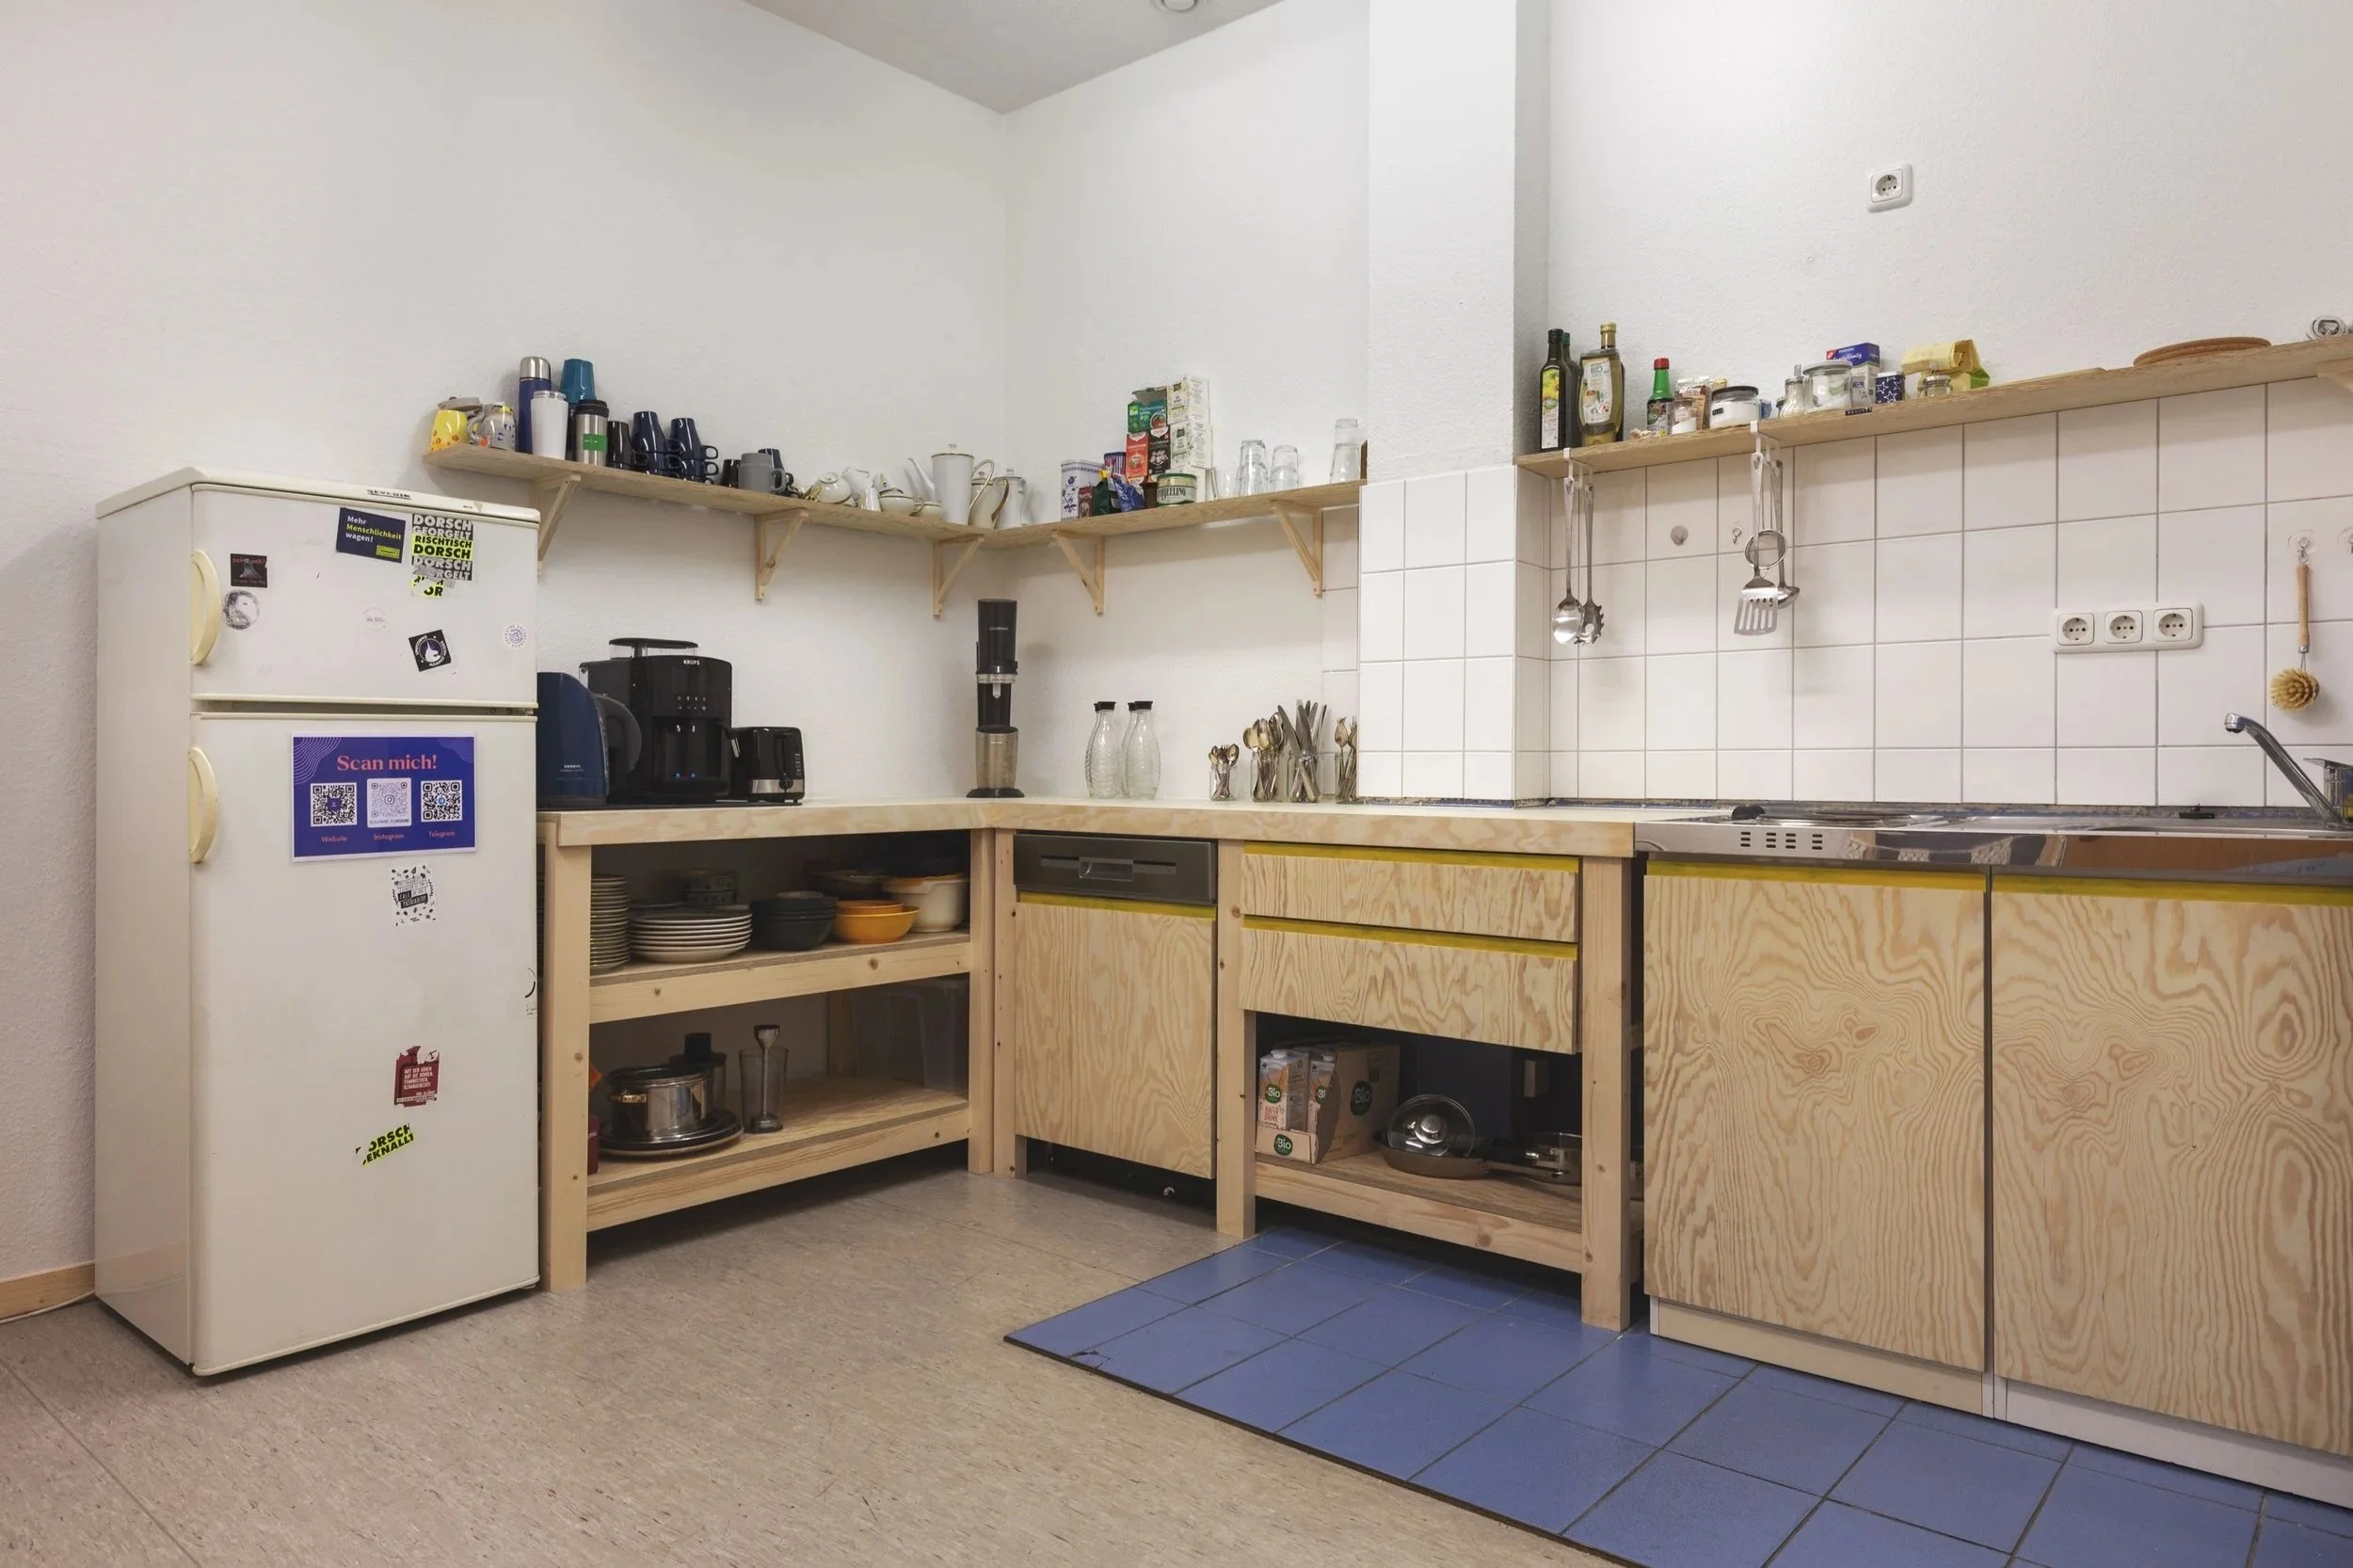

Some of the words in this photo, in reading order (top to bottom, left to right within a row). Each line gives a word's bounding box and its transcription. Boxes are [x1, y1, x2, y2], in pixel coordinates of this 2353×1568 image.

[347, 516, 367, 525] Mehr
[413, 514, 472, 532] DORSCH
[345, 533, 374, 543] wagen!
[346, 523, 402, 540] Menschlichkeit
[412, 525, 472, 540] GEORGELT
[415, 535, 472, 549] RISCHTISCH
[413, 544, 472, 560] DORSCH
[413, 556, 472, 571] DORSCH
[336, 755, 384, 771] Scan
[388, 754, 438, 770] mich!
[321, 835, 347, 843] Website
[373, 833, 405, 841] Instagram
[428, 830, 456, 839] Telegram
[1268, 1087, 1281, 1098] Bio
[1318, 1089, 1326, 1099] Bi
[1353, 1087, 1370, 1104] Bio
[356, 1122, 410, 1154] ORSCH
[1277, 1137, 1292, 1149] Bio
[362, 1132, 414, 1166] EKNALLT
